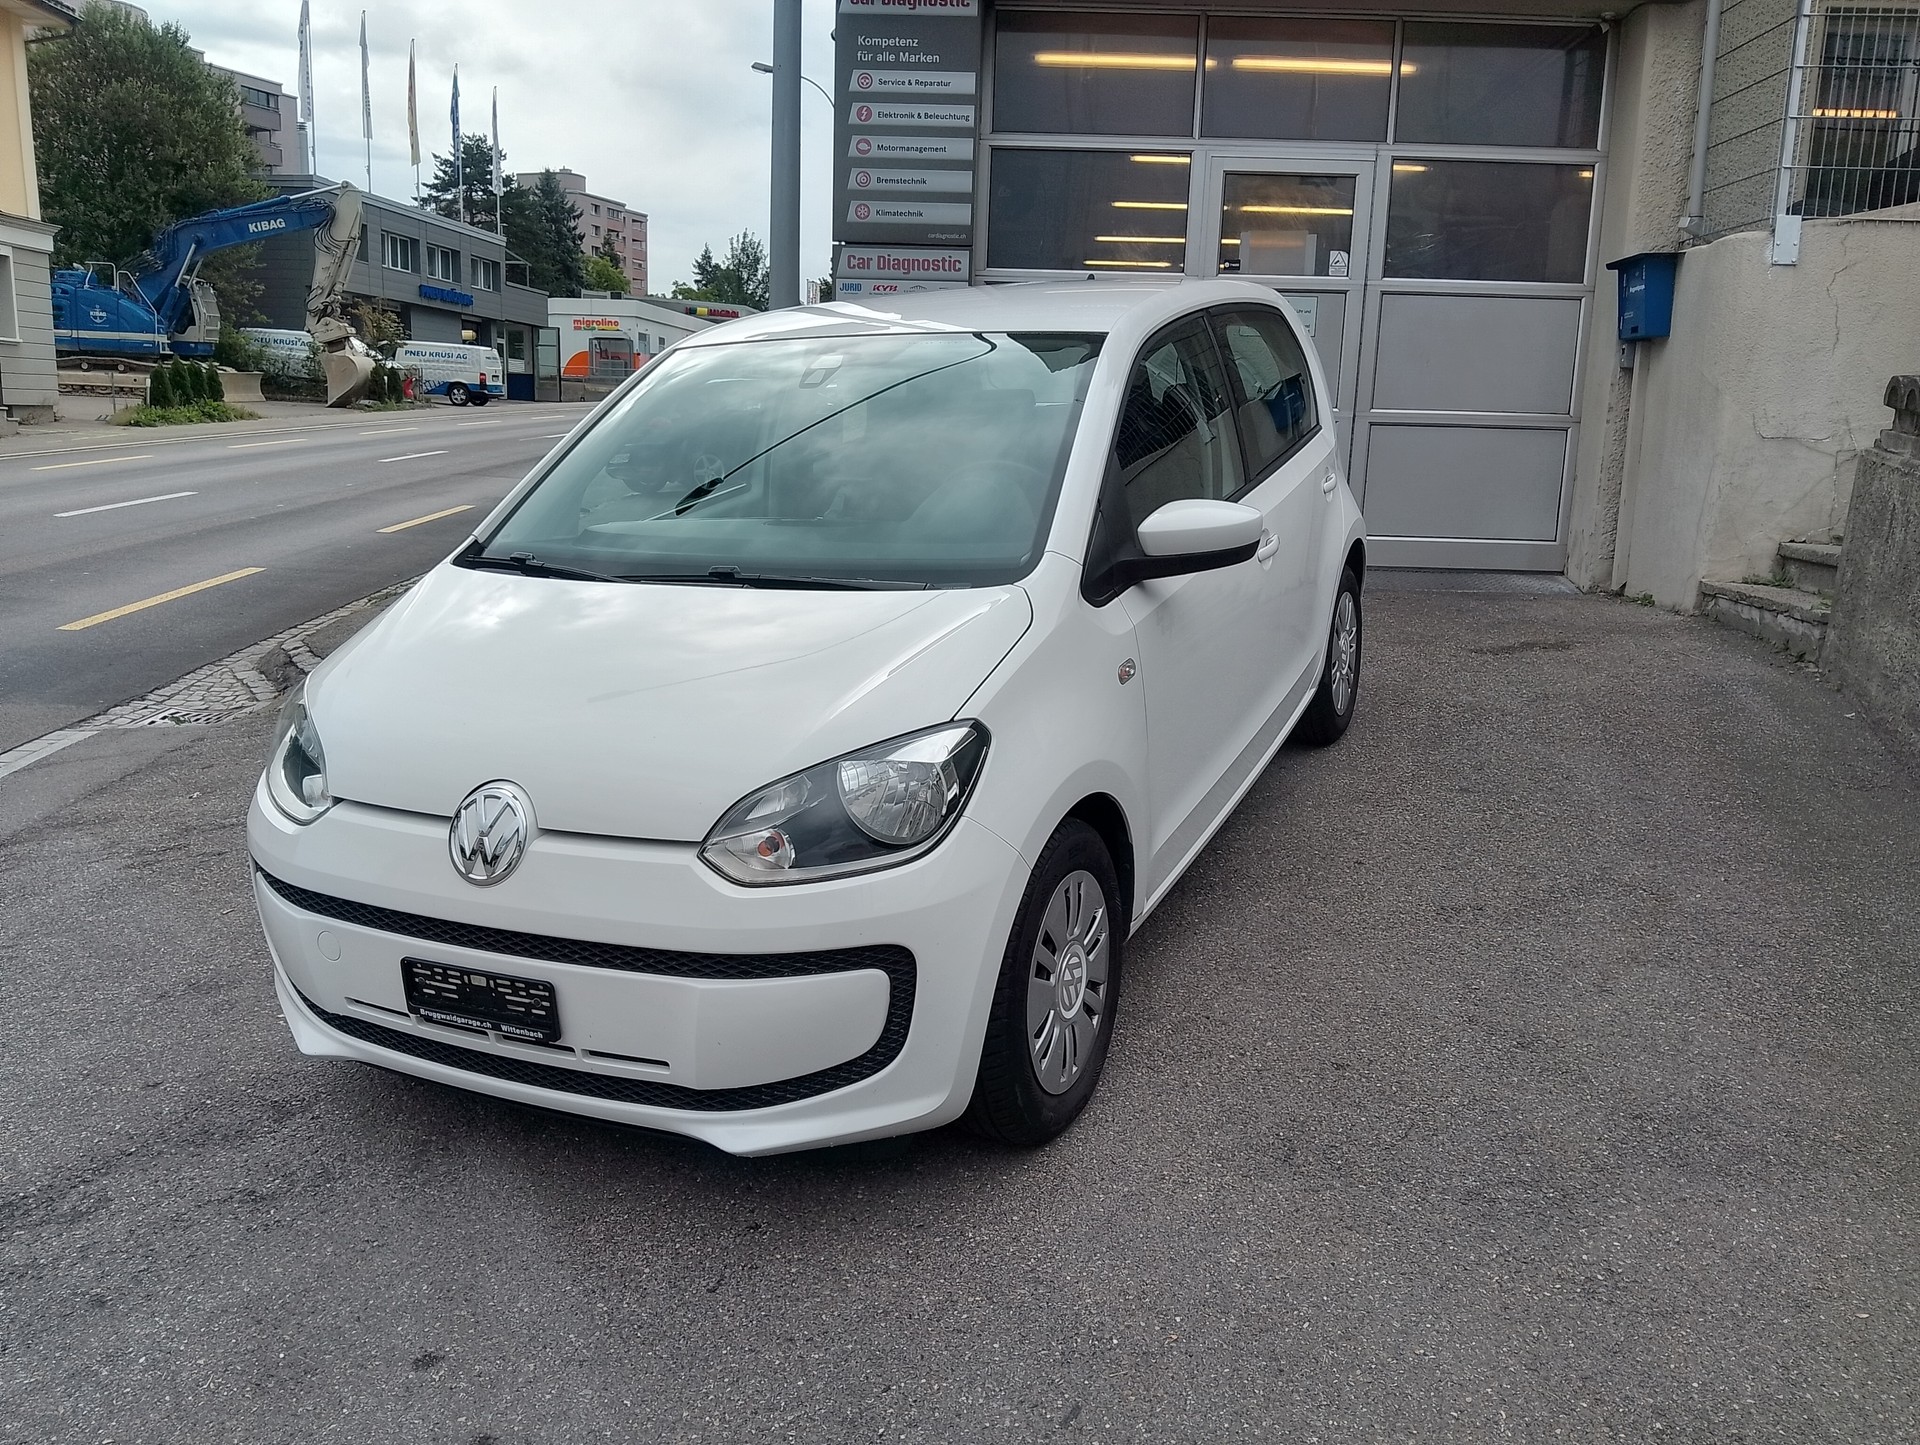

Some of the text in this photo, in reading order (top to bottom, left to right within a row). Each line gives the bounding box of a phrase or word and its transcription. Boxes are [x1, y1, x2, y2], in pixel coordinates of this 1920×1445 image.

[857, 35, 919, 48] Kompetenz
[857, 50, 940, 63] für alle Marken
[878, 78, 906, 87] Service
[914, 79, 952, 88] Reparatur
[877, 111, 970, 122] Elektronik & Beleuchtung
[876, 144, 947, 154] Motormanagement
[876, 176, 927, 185] Bremstechnik
[875, 209, 924, 218] Klimatechnik
[248, 218, 286, 233] KIBAG
[927, 232, 967, 240] cardiagnostic.ch
[847, 253, 962, 275] Car Diagnostic
[839, 282, 862, 292] JURID
[872, 284, 898, 292] KYB
[573, 316, 620, 328] migrolino
[404, 349, 427, 358] PNEU
[419, 1008, 544, 1039] Bruggwaldgarage.ch Wittenbach
